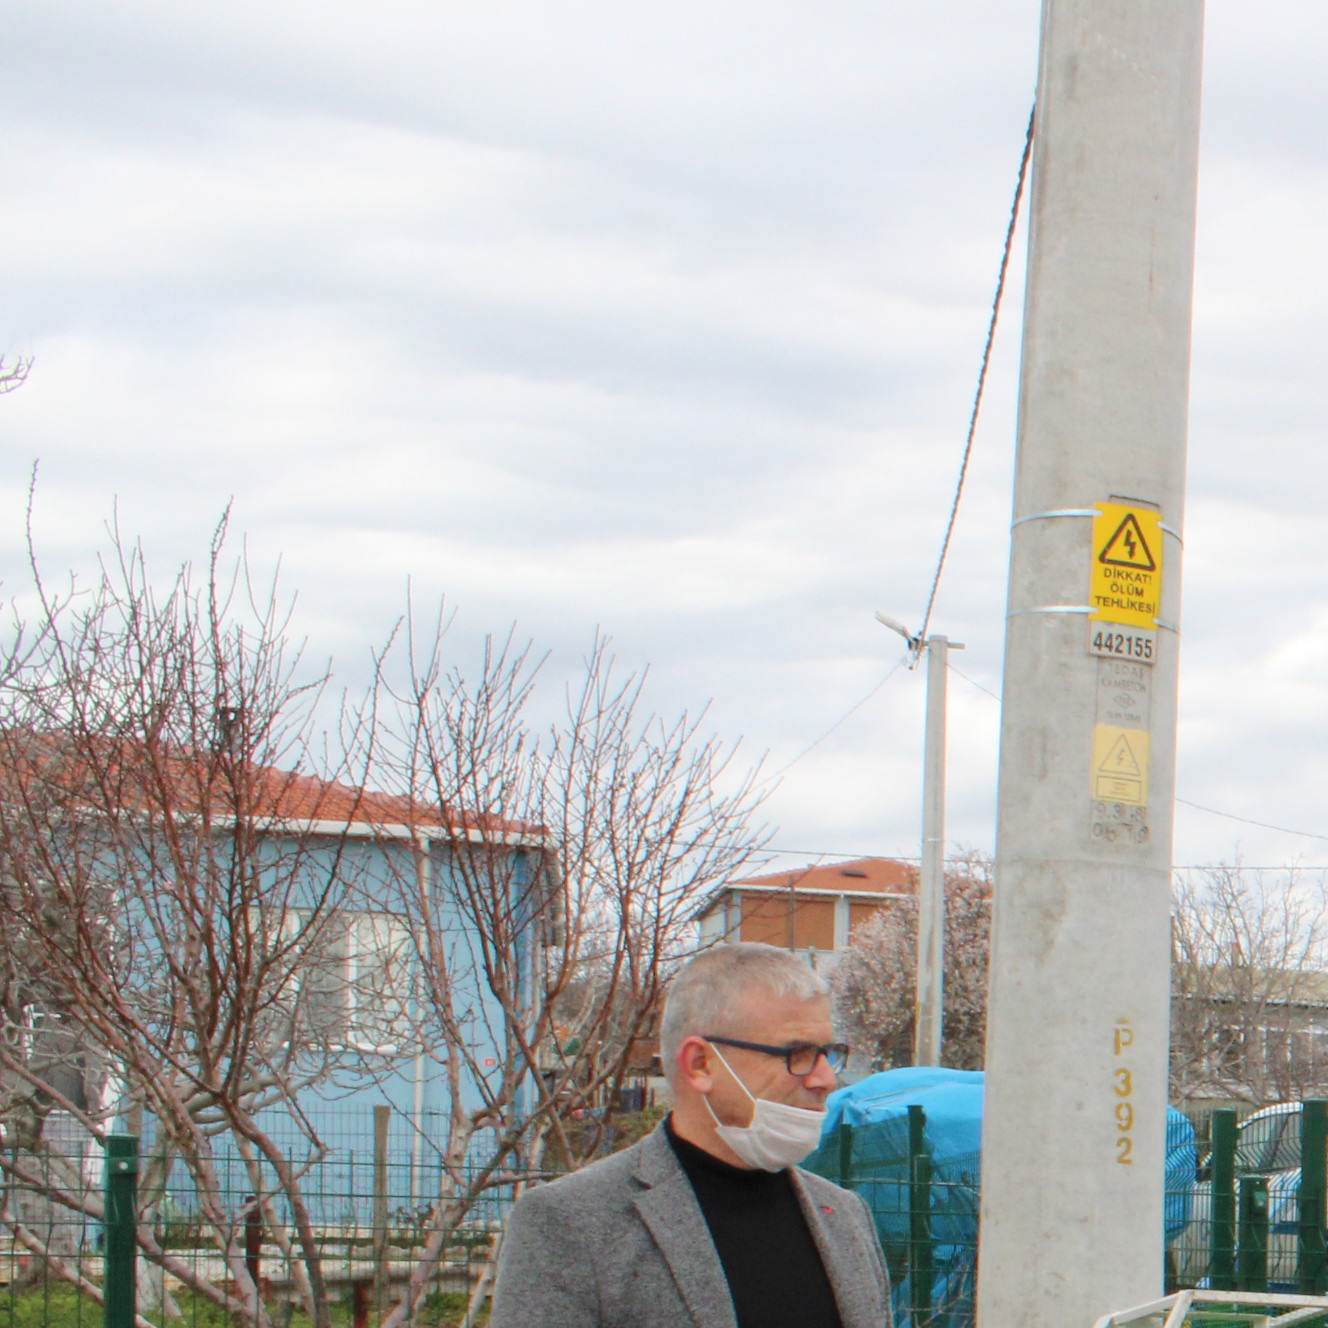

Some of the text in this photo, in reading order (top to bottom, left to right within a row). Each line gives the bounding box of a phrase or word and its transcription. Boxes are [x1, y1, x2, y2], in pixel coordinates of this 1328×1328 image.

[1103, 567, 1153, 585] DİKKAT!
[1110, 582, 1144, 598] ÖLÜM
[1095, 595, 1156, 614] TEHLİKESİ
[1093, 632, 1153, 658] 442155
